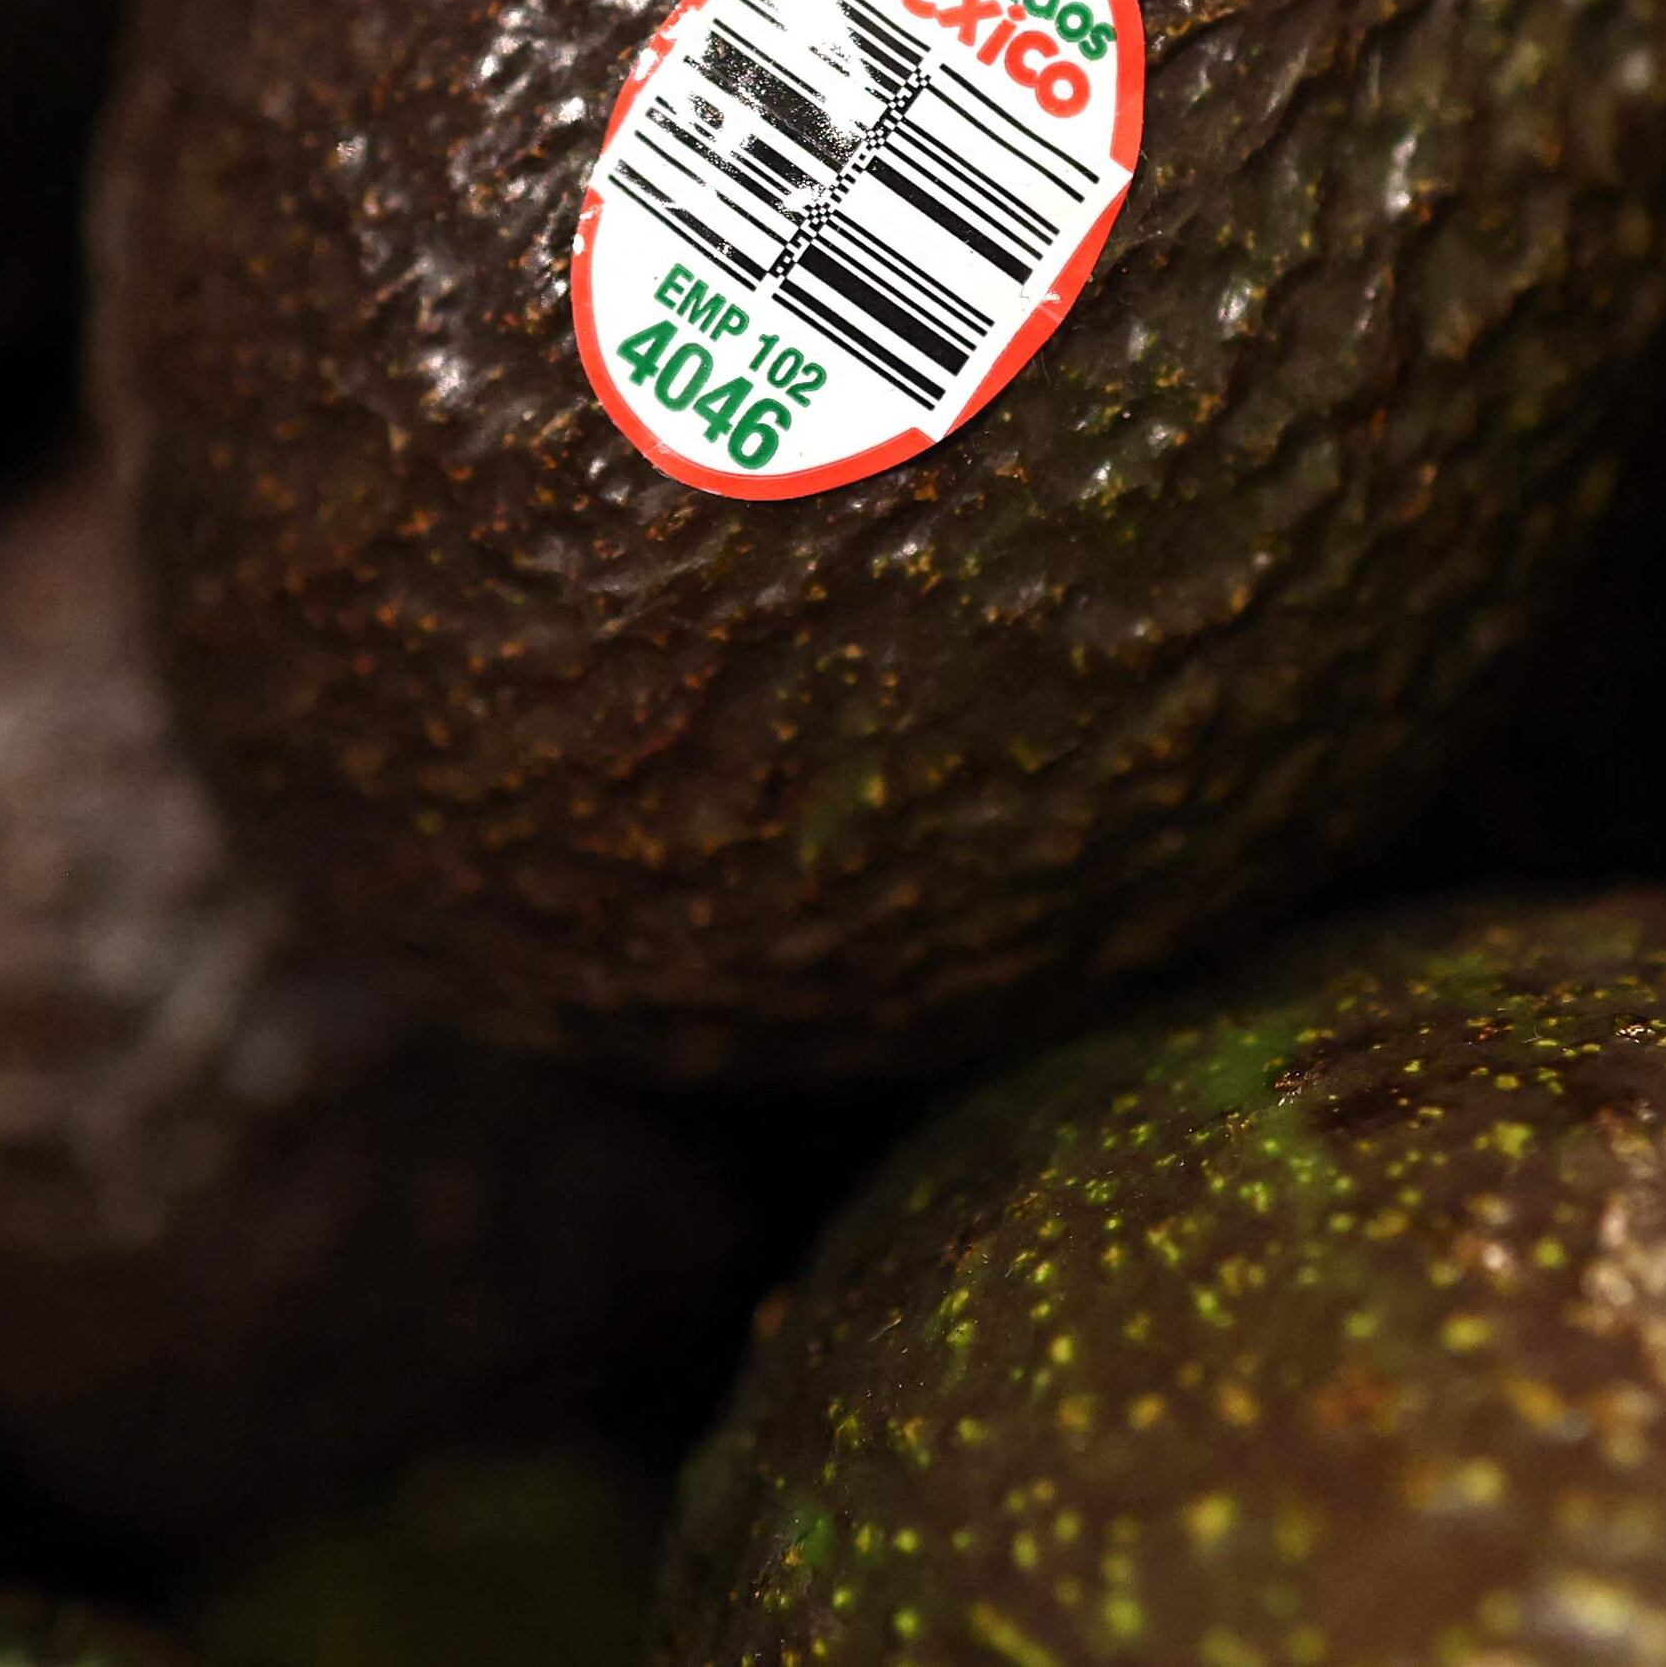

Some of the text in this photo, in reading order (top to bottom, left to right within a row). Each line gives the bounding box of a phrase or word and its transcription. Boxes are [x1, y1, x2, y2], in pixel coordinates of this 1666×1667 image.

[616, 319, 792, 470] 4046
[654, 263, 828, 409] EMP 102
